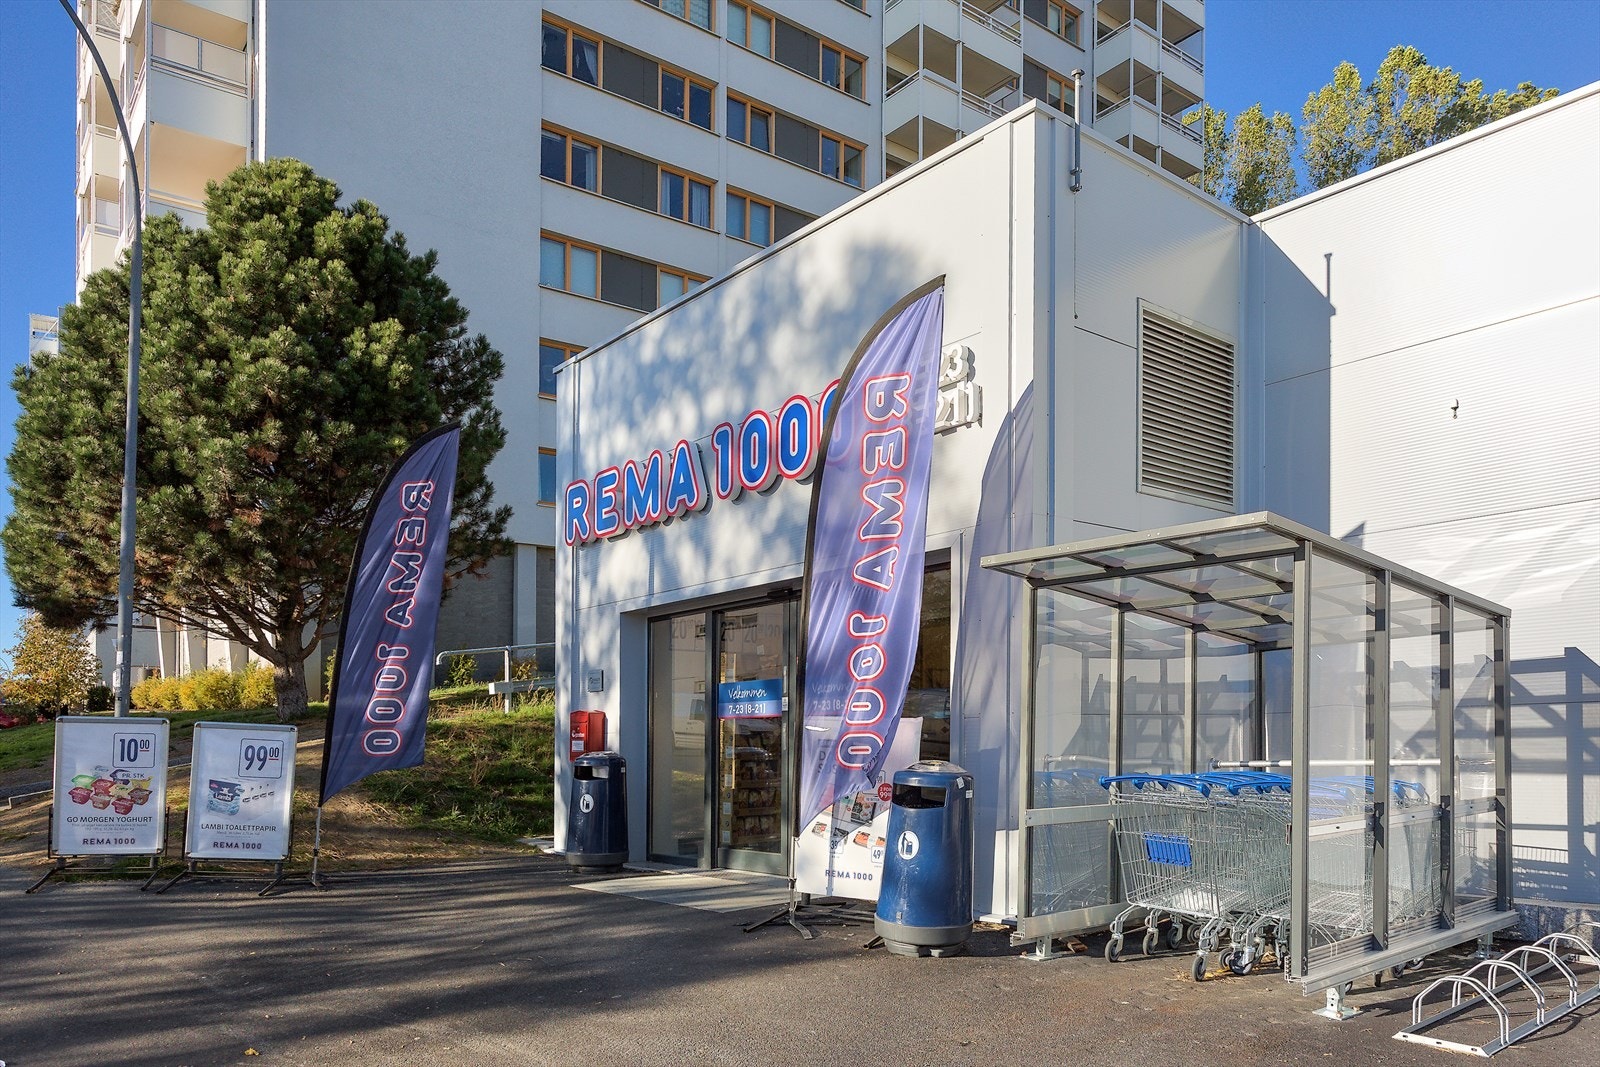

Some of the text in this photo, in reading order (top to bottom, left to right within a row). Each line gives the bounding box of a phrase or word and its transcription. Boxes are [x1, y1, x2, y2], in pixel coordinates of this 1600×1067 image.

[564, 438, 701, 547] REMA
[728, 704, 744, 714] 7-23
[226, 824, 277, 832] TOALETTPAPIR
[213, 841, 262, 850] REMA 1000
[825, 869, 873, 881] REMA 1000
